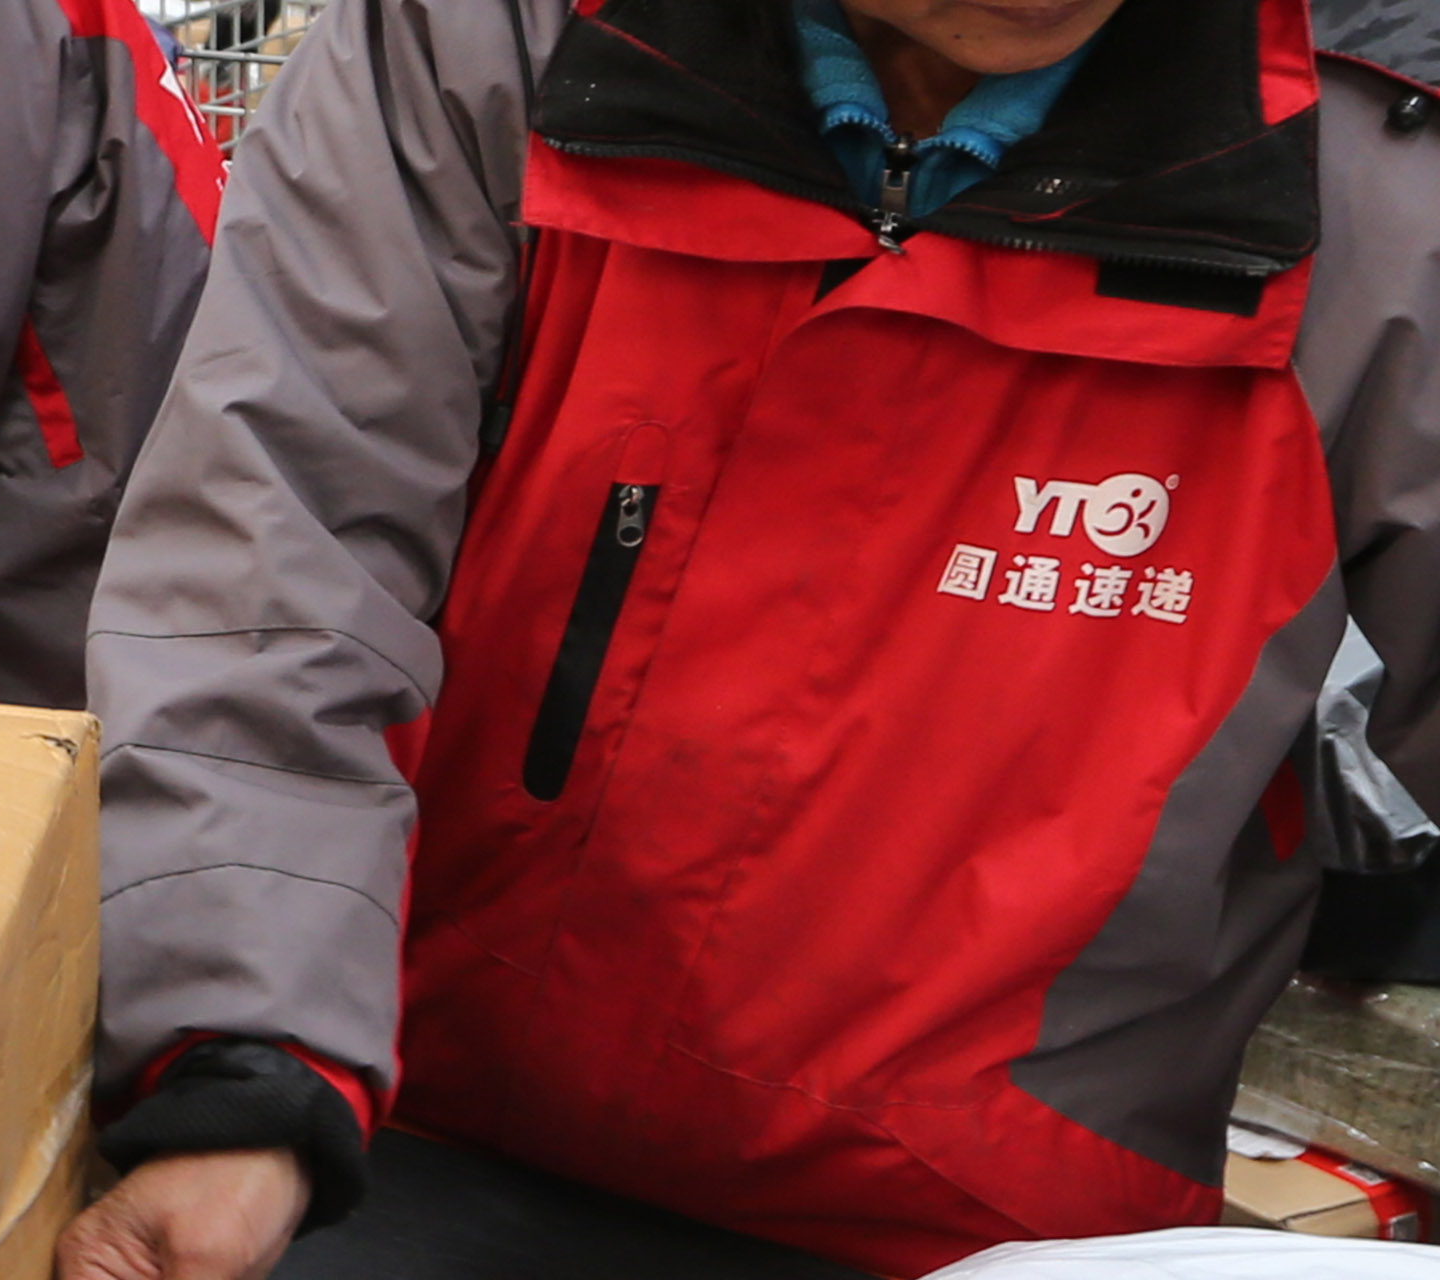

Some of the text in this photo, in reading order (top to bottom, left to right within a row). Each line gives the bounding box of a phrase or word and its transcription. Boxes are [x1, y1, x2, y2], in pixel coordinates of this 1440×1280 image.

[1013, 472, 1172, 558] YTO
[936, 543, 1193, 624] 圆通速递
